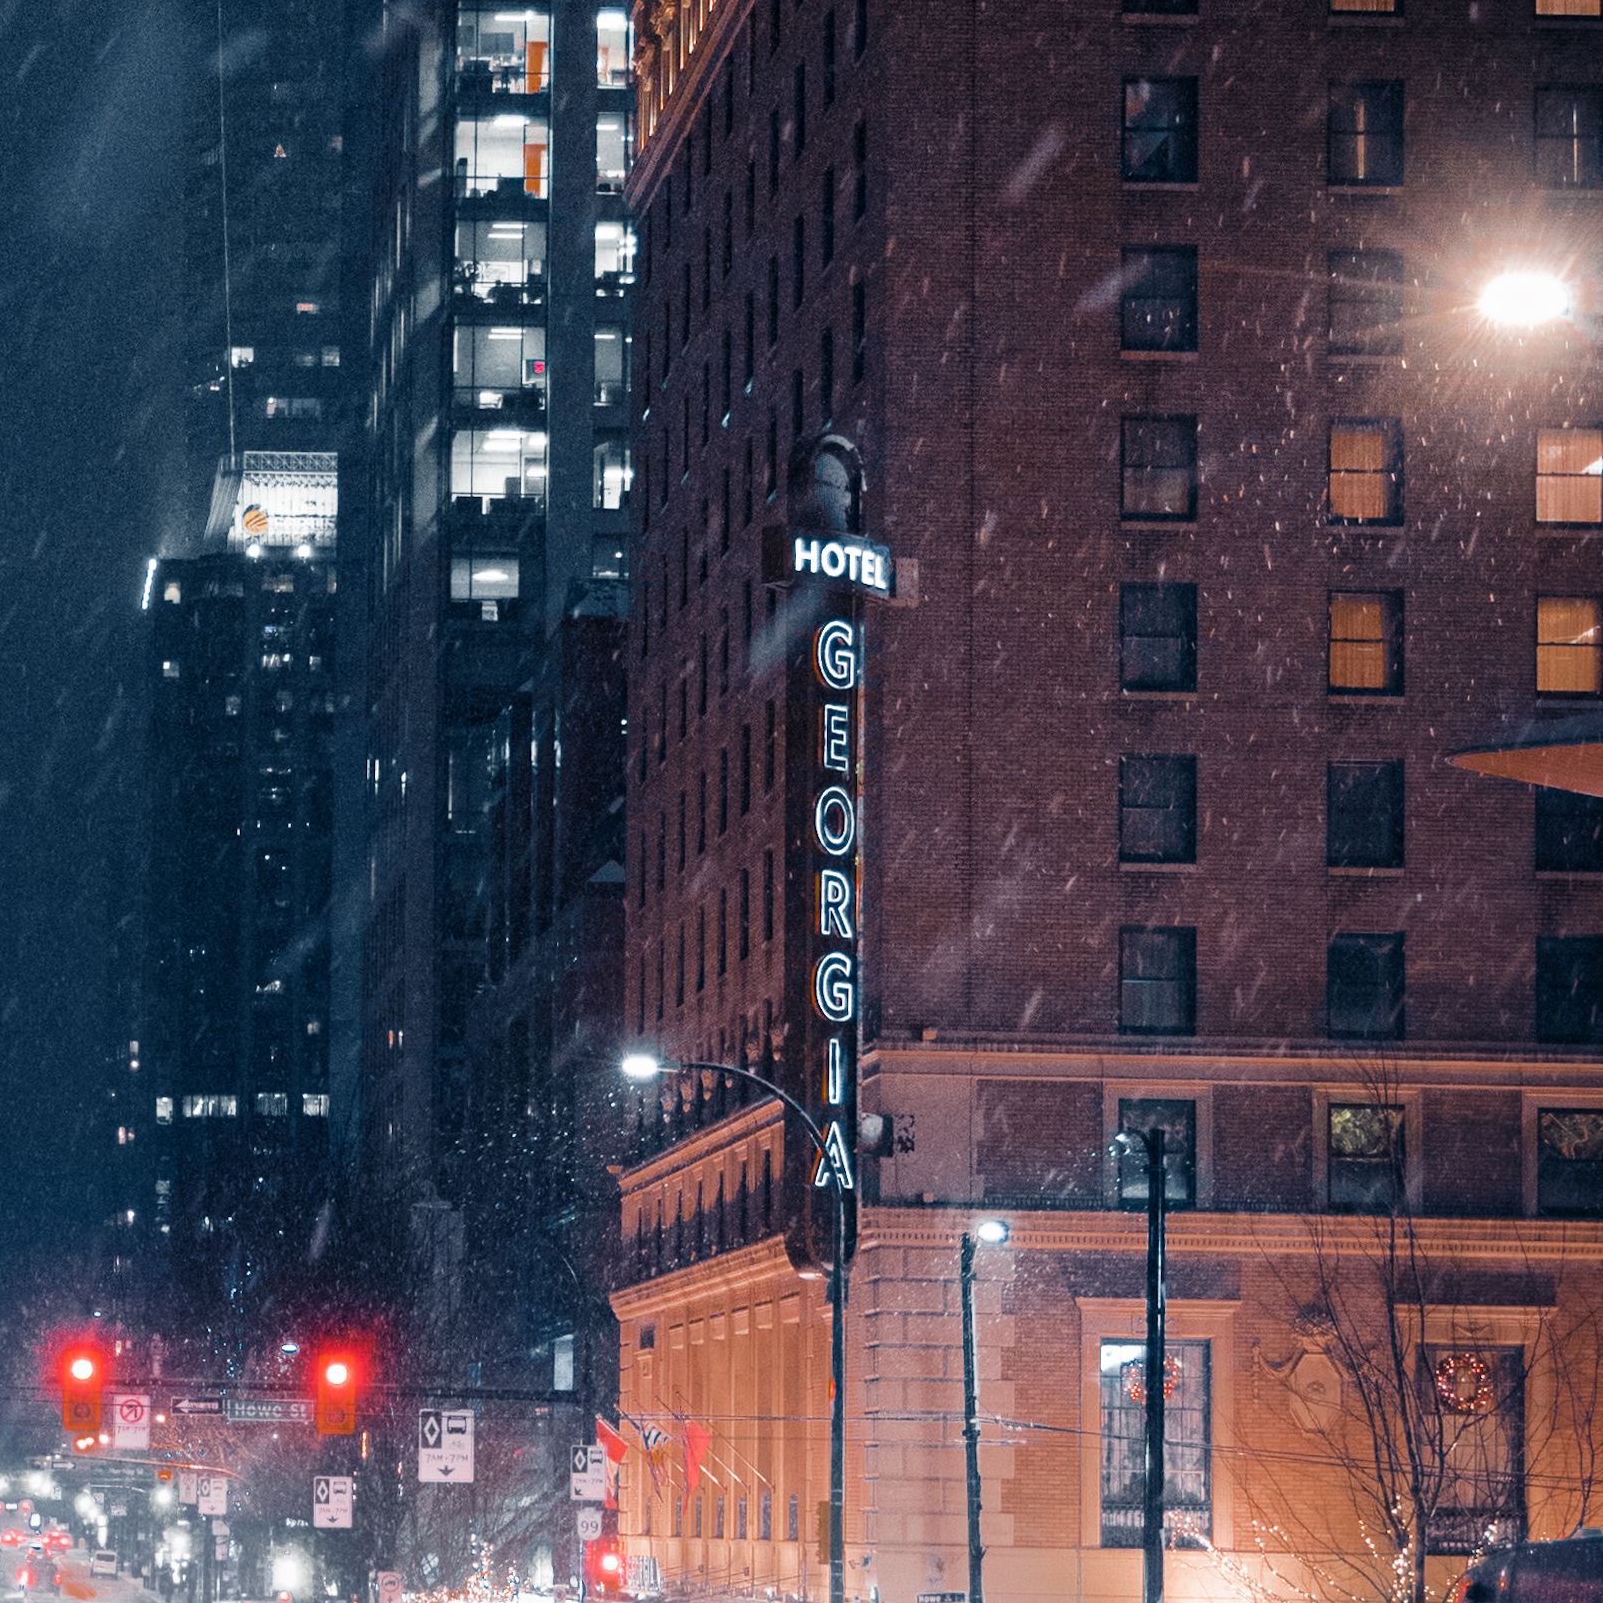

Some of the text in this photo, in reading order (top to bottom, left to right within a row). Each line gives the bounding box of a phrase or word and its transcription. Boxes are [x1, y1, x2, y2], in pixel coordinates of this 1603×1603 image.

[794, 537, 888, 590] HOTEL
[814, 619, 856, 1190] GEORGIA
[234, 1402, 283, 1417] Howe
[289, 1403, 307, 1417] St
[580, 1520, 600, 1534] 99
